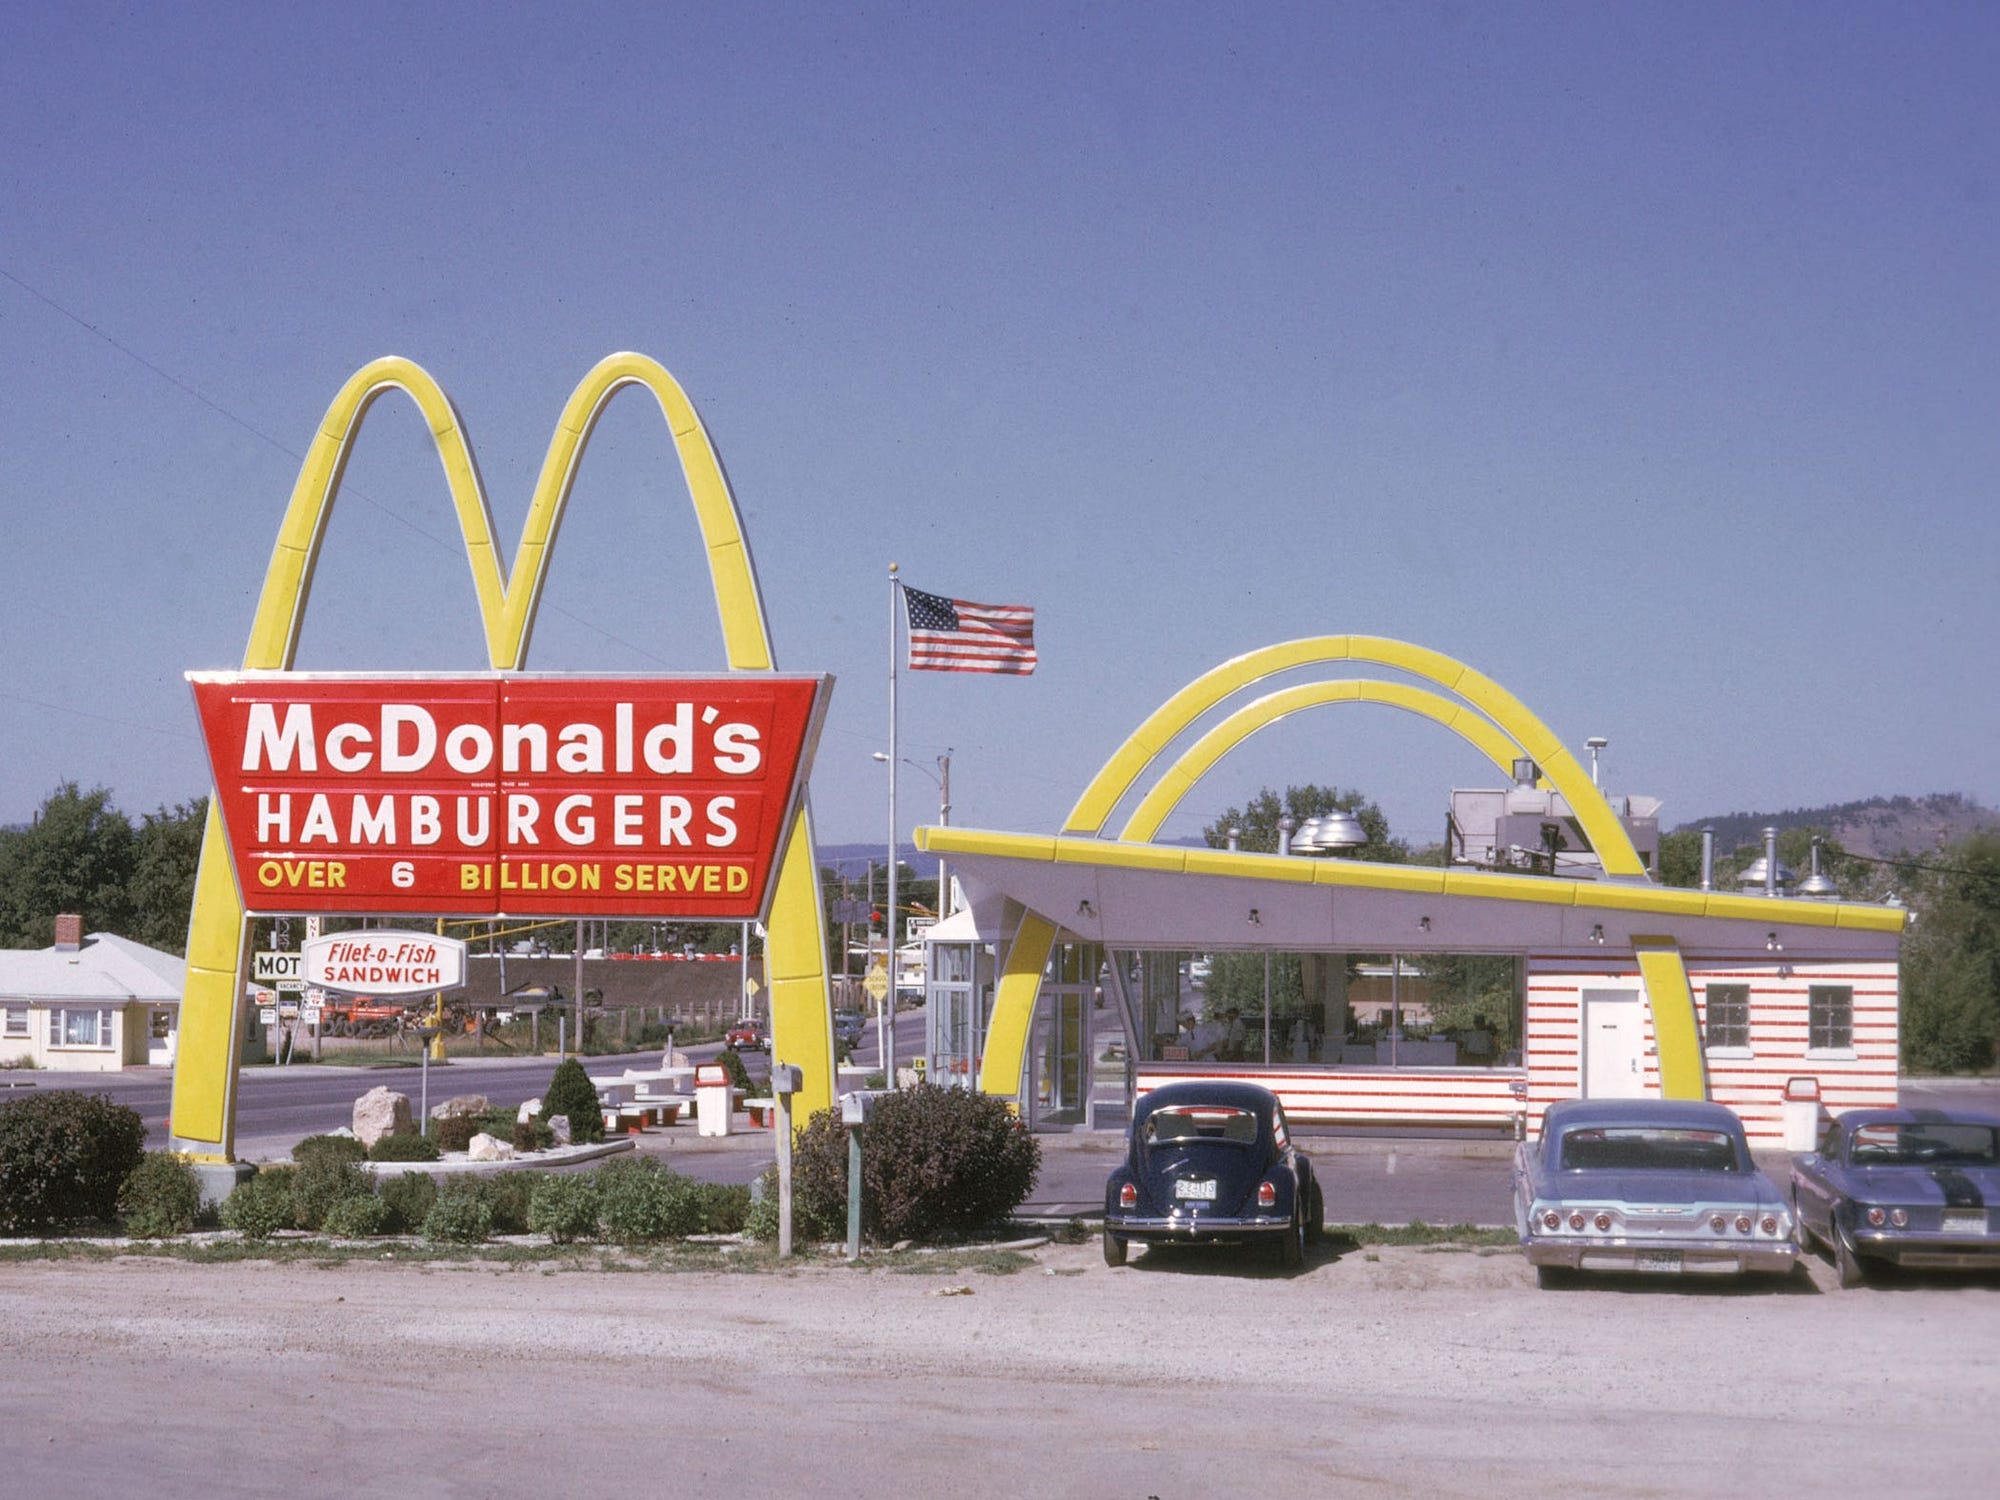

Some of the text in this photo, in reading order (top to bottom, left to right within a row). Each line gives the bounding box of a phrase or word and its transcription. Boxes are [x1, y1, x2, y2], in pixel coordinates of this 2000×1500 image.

[241, 702, 761, 774] McDonald's
[257, 791, 737, 847] HAMBURGERS
[258, 861, 749, 893] OVER 6 BILLION SERVED
[327, 942, 437, 964] Filet-o-Fish
[323, 966, 440, 984] SANDWICH
